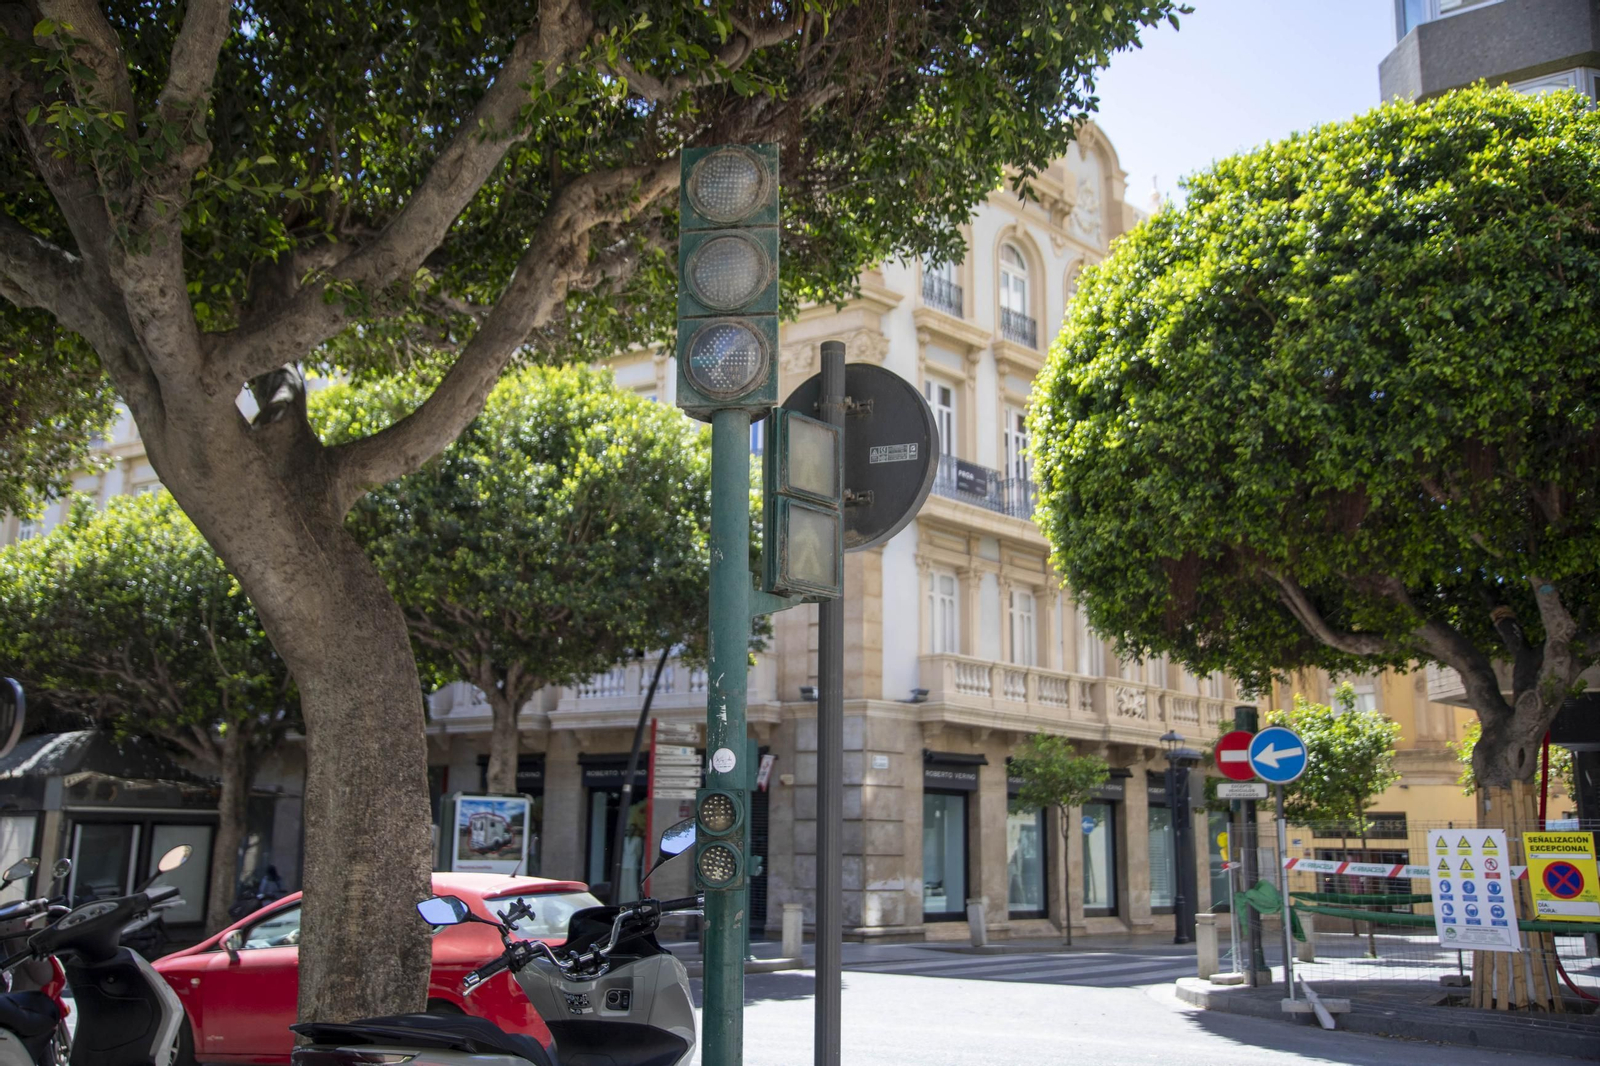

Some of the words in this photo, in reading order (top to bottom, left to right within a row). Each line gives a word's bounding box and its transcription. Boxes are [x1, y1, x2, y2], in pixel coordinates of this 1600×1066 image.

[586, 769, 618, 777] ROBERTO
[925, 769, 953, 779] ROBERTO
[954, 772, 976, 781] VERINO
[1528, 835, 1589, 844] SEÑALIZACIÓN
